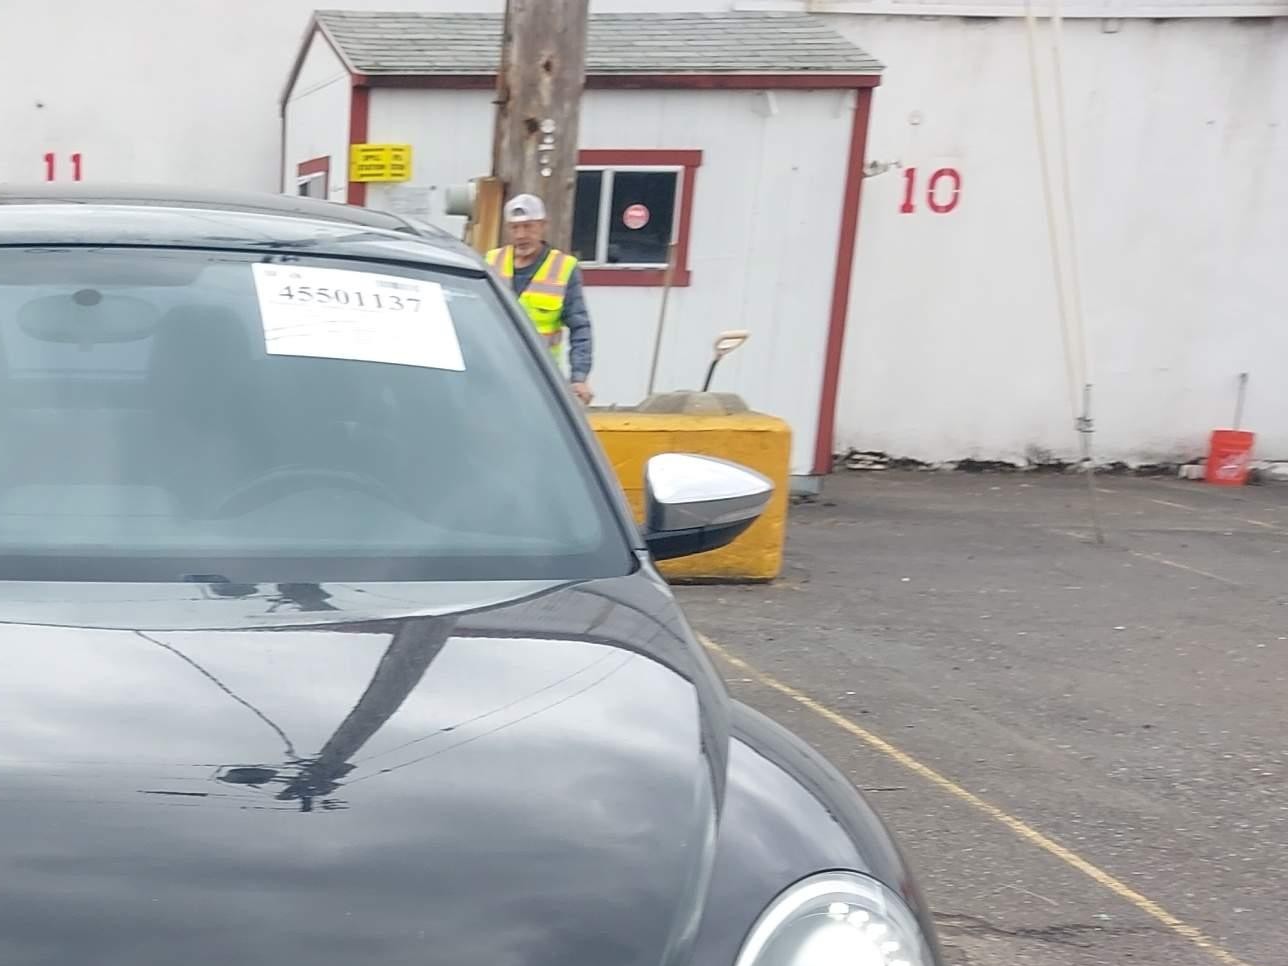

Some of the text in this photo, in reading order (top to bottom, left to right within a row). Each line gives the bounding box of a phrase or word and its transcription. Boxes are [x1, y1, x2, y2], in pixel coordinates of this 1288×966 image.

[45, 153, 83, 181] 11
[900, 167, 961, 214] 10
[279, 285, 422, 312] 45501137
